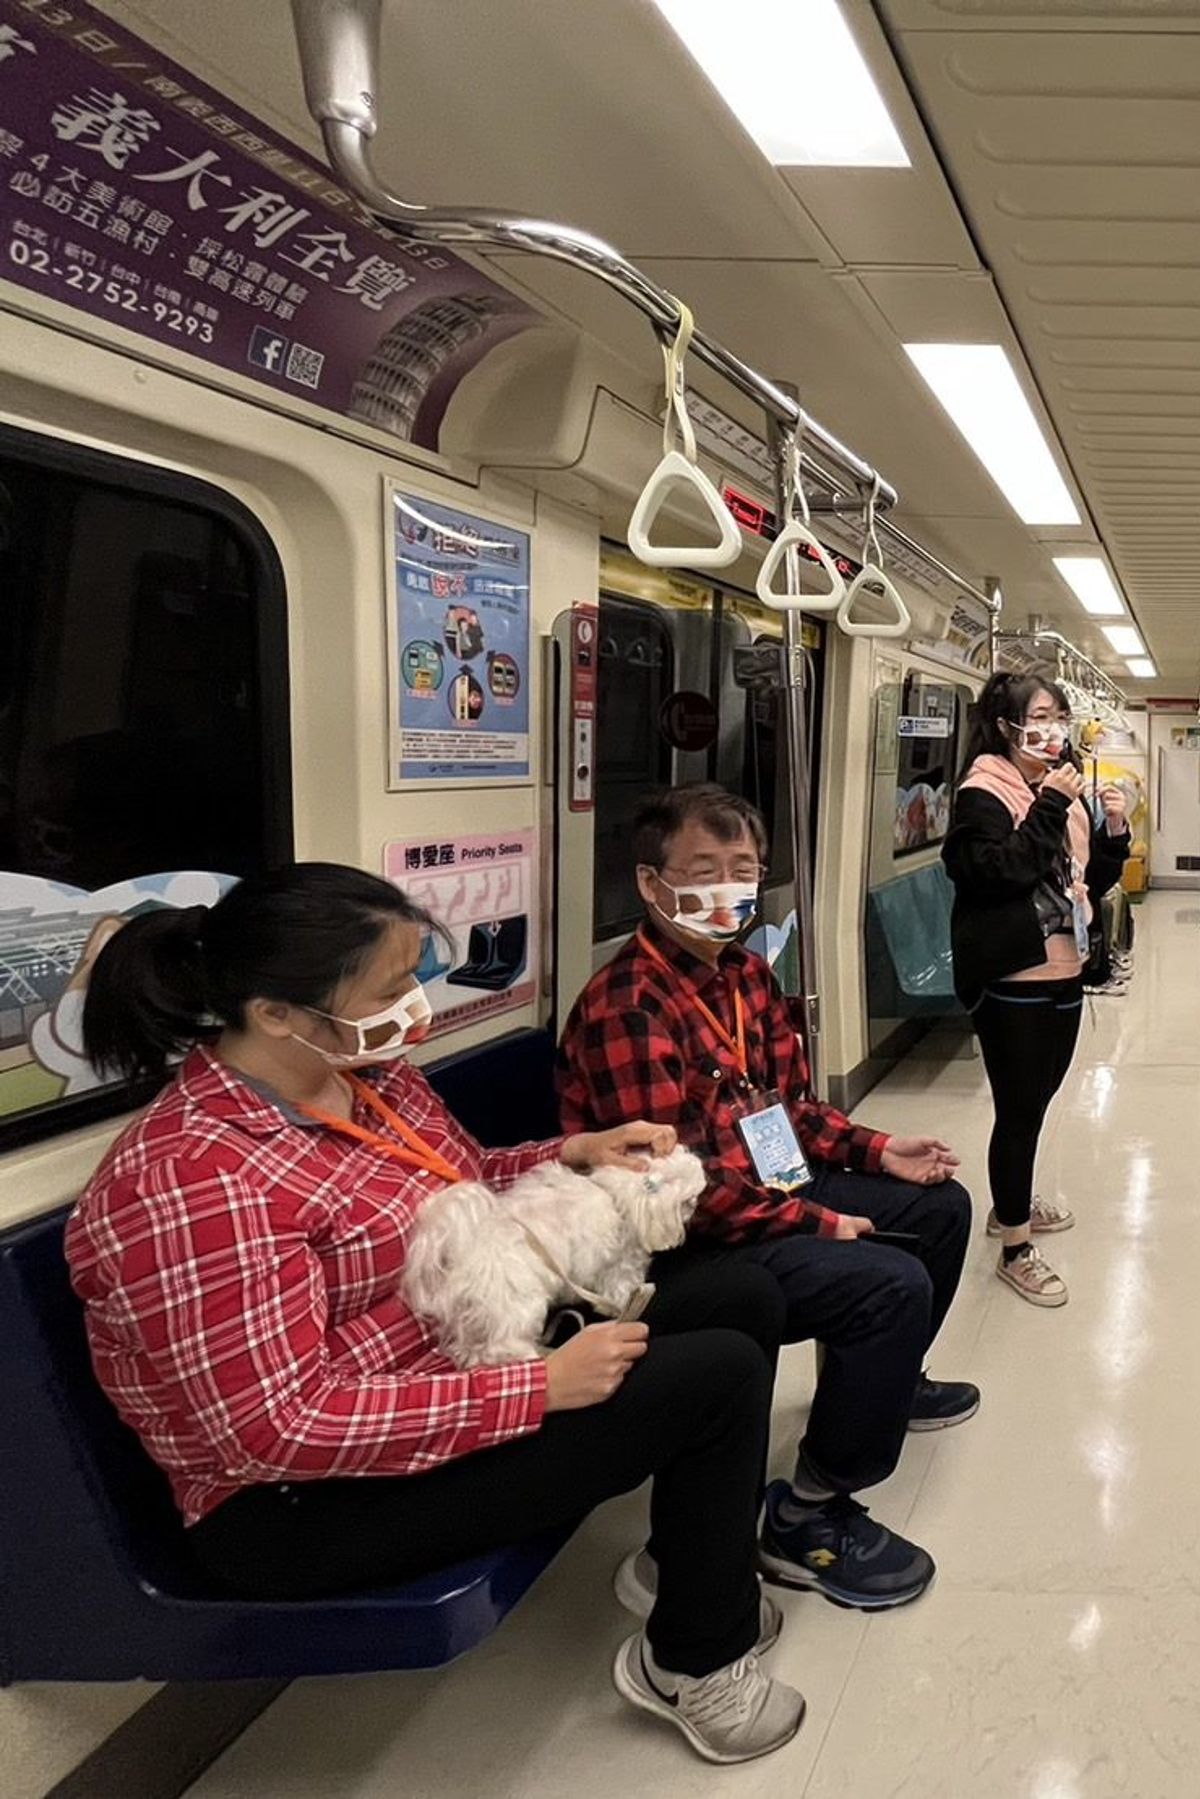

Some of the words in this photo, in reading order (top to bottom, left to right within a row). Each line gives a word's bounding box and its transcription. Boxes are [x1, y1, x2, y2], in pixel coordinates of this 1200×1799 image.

[50, 86, 416, 312] 義大利全覽
[9, 240, 214, 344] 02-2752-9293
[404, 844, 455, 869] 博愛座
[461, 846, 496, 860] Priority
